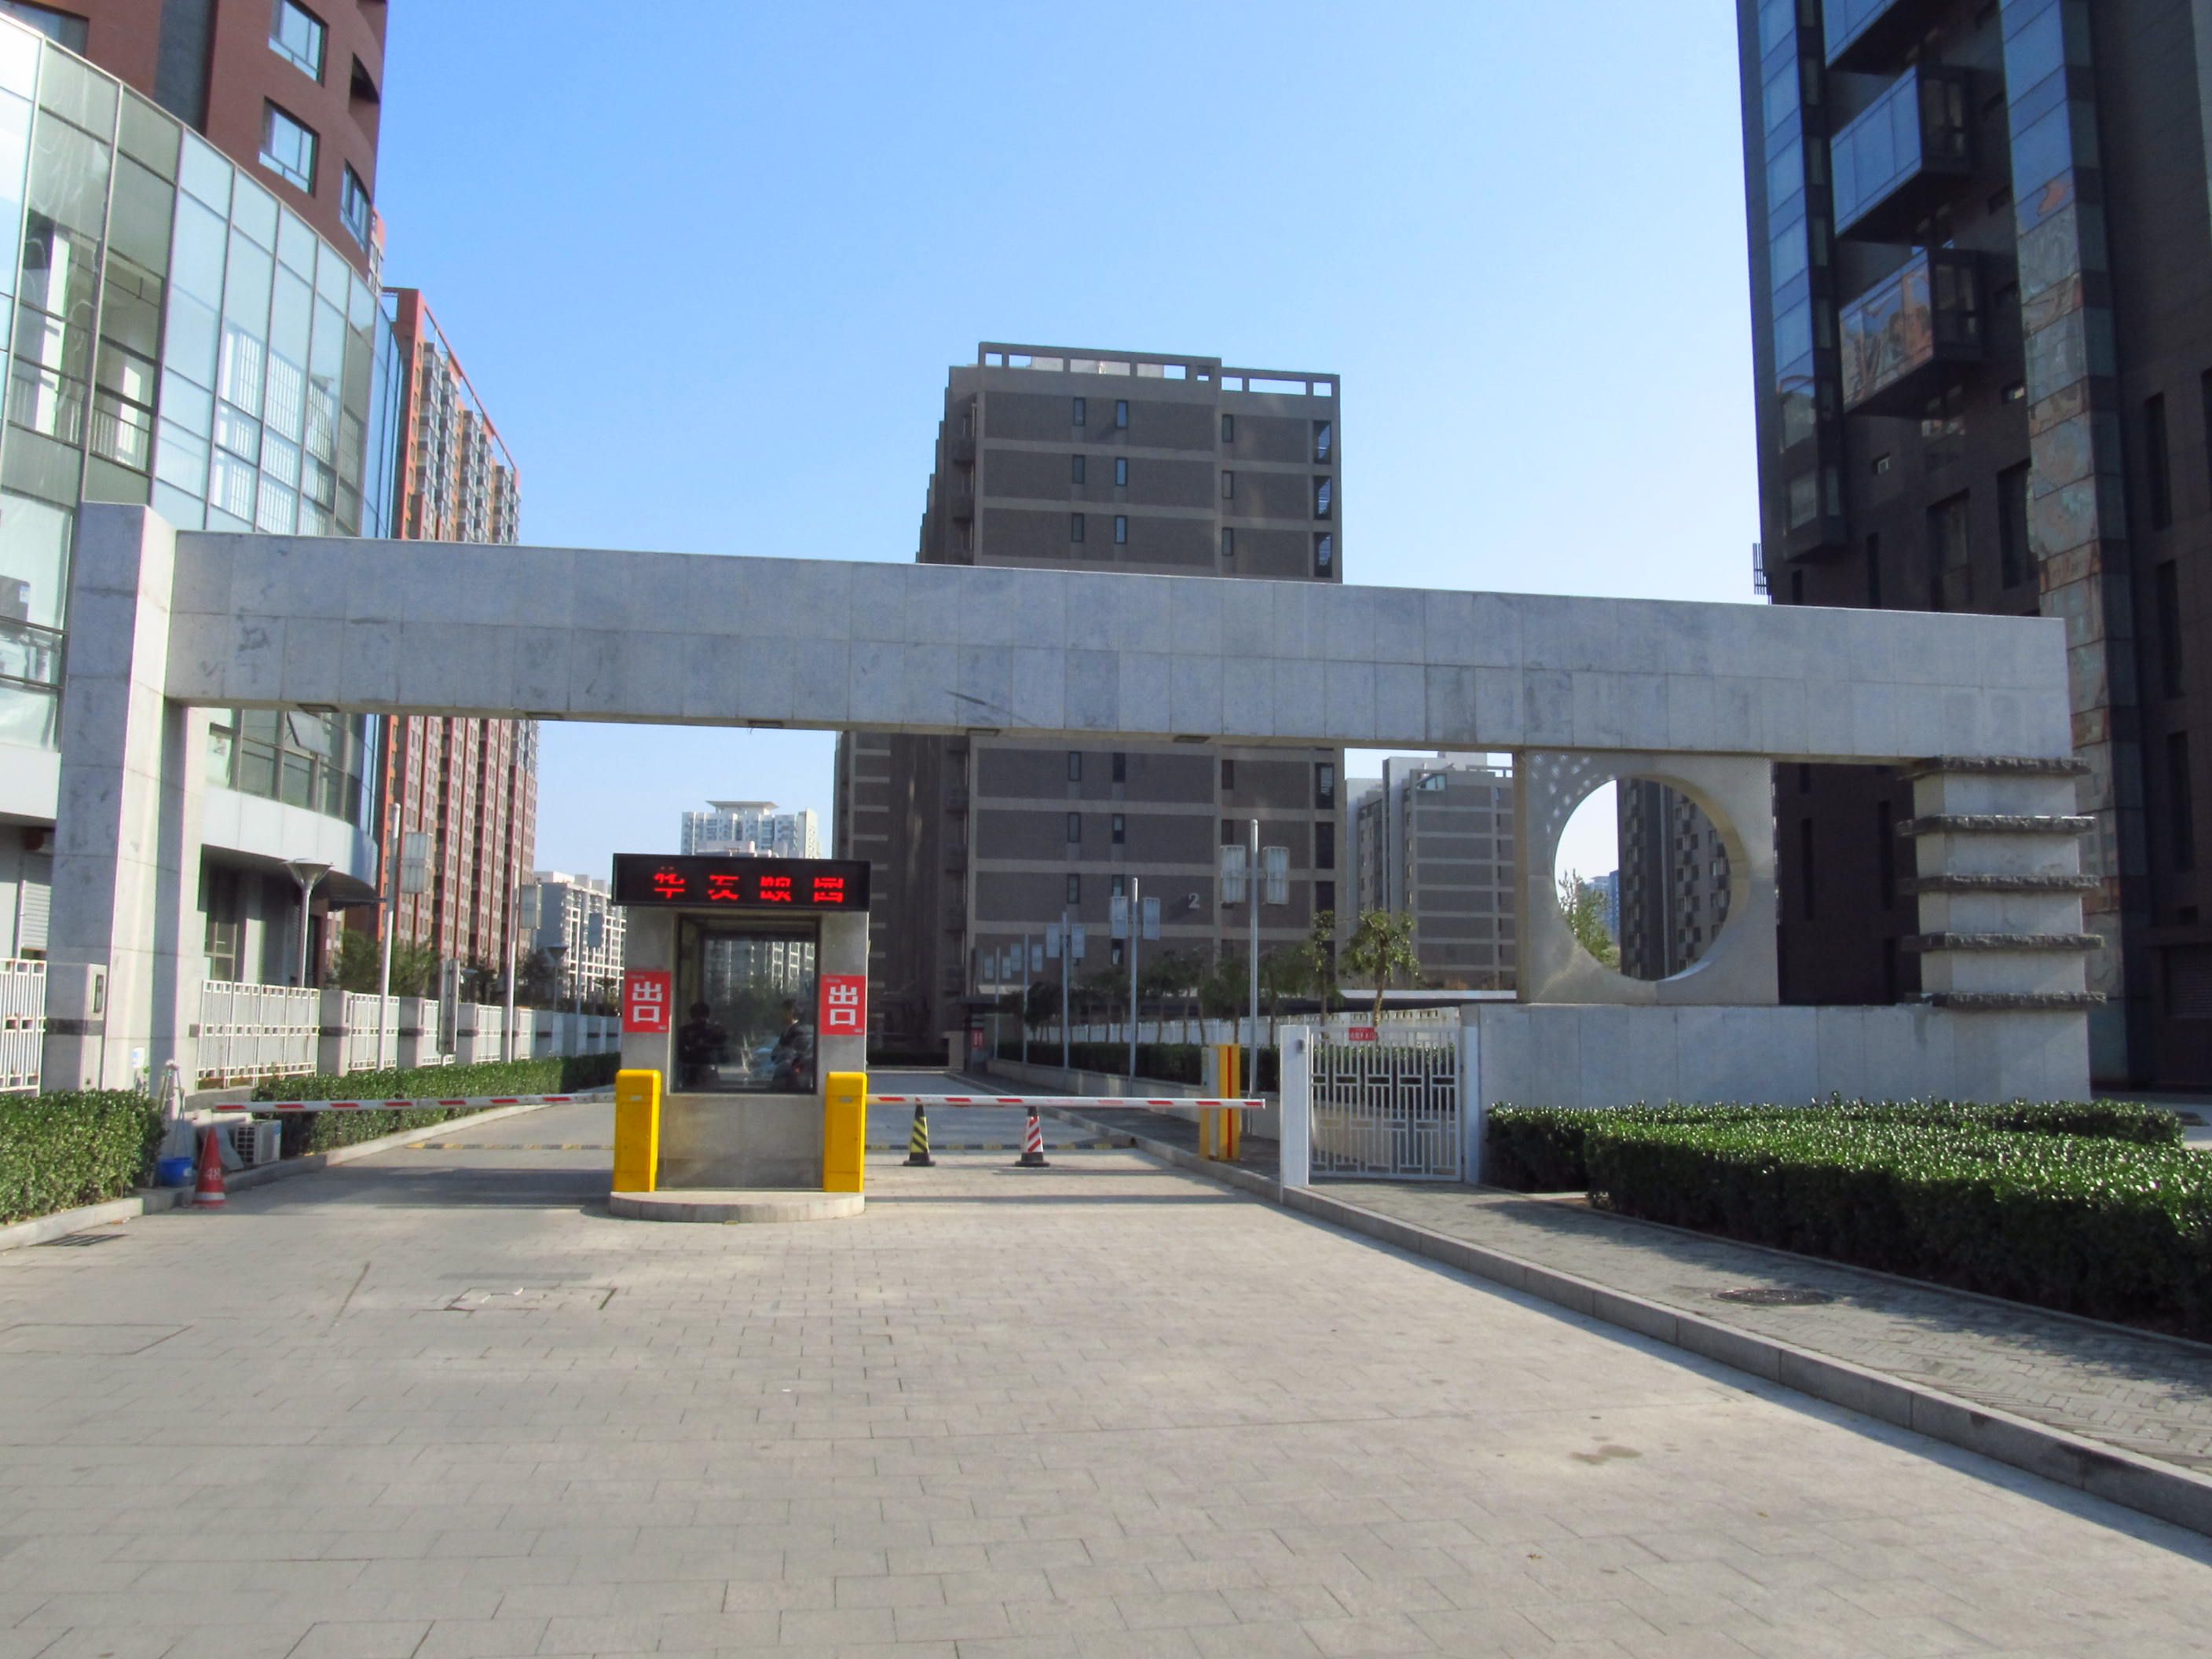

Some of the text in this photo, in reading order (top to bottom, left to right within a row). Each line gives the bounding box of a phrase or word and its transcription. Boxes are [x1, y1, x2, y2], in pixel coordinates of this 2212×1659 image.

[1188, 892, 1200, 909] 2
[632, 981, 662, 1023] 出口
[829, 984, 859, 1026] 出口
